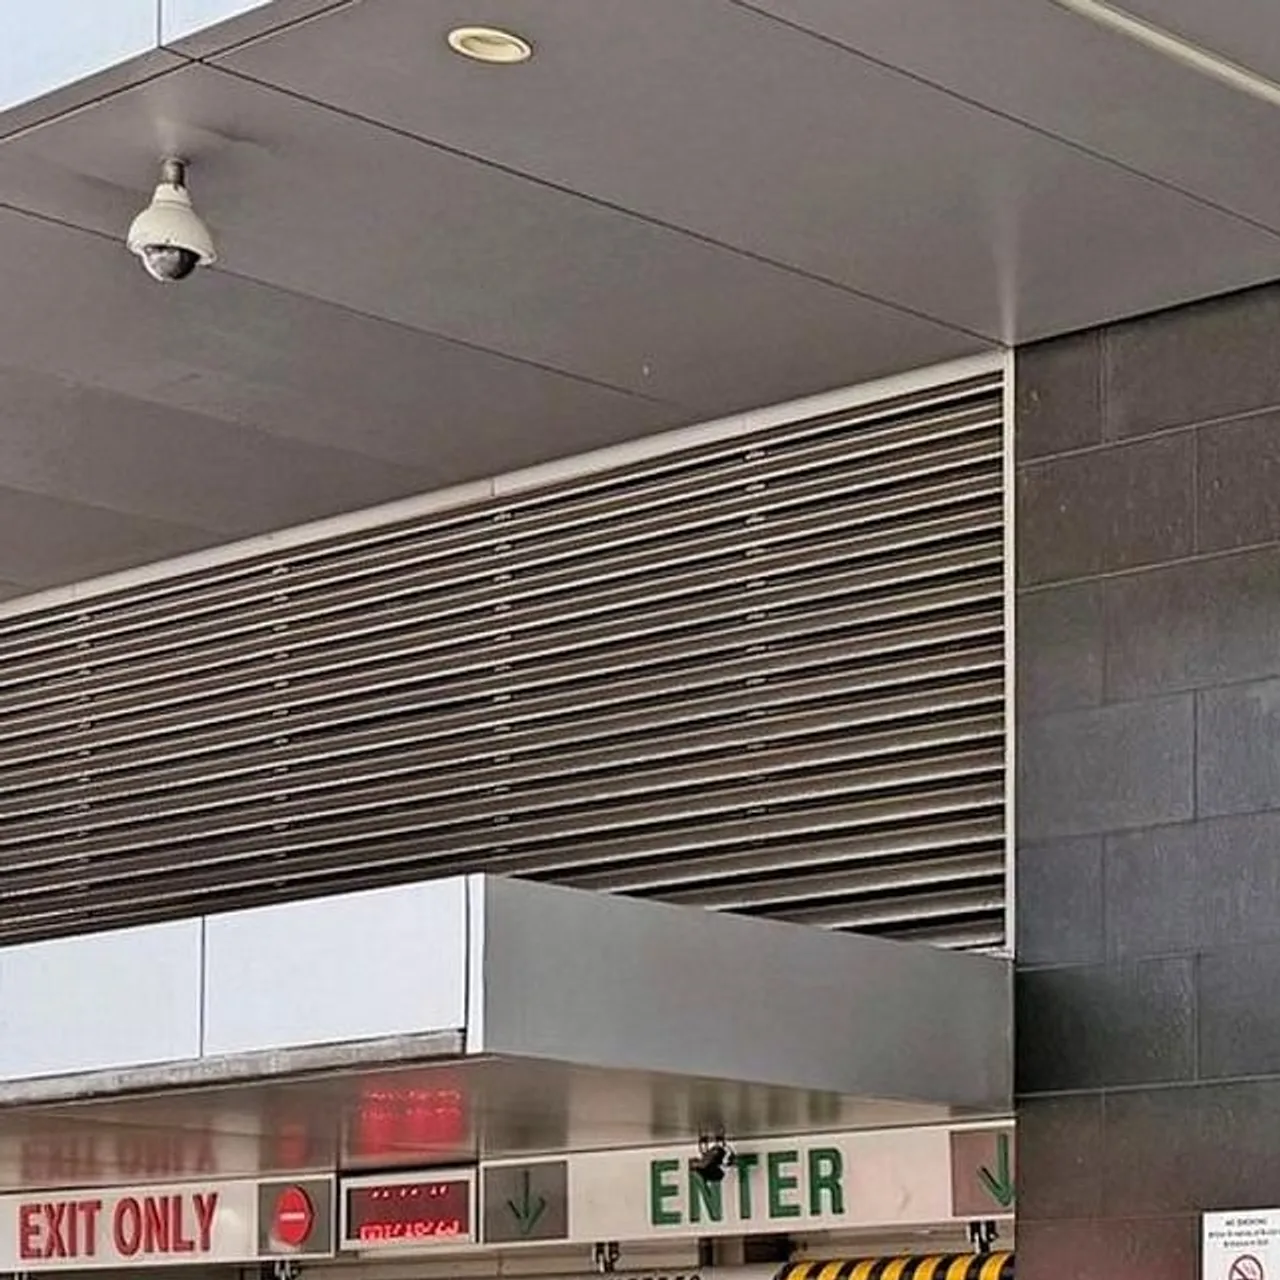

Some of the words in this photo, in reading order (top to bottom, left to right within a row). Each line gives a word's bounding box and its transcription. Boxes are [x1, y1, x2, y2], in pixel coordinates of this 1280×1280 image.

[649, 1146, 845, 1226] ENTER
[19, 1200, 103, 1260] EXIT
[112, 1192, 219, 1256] ONLY
